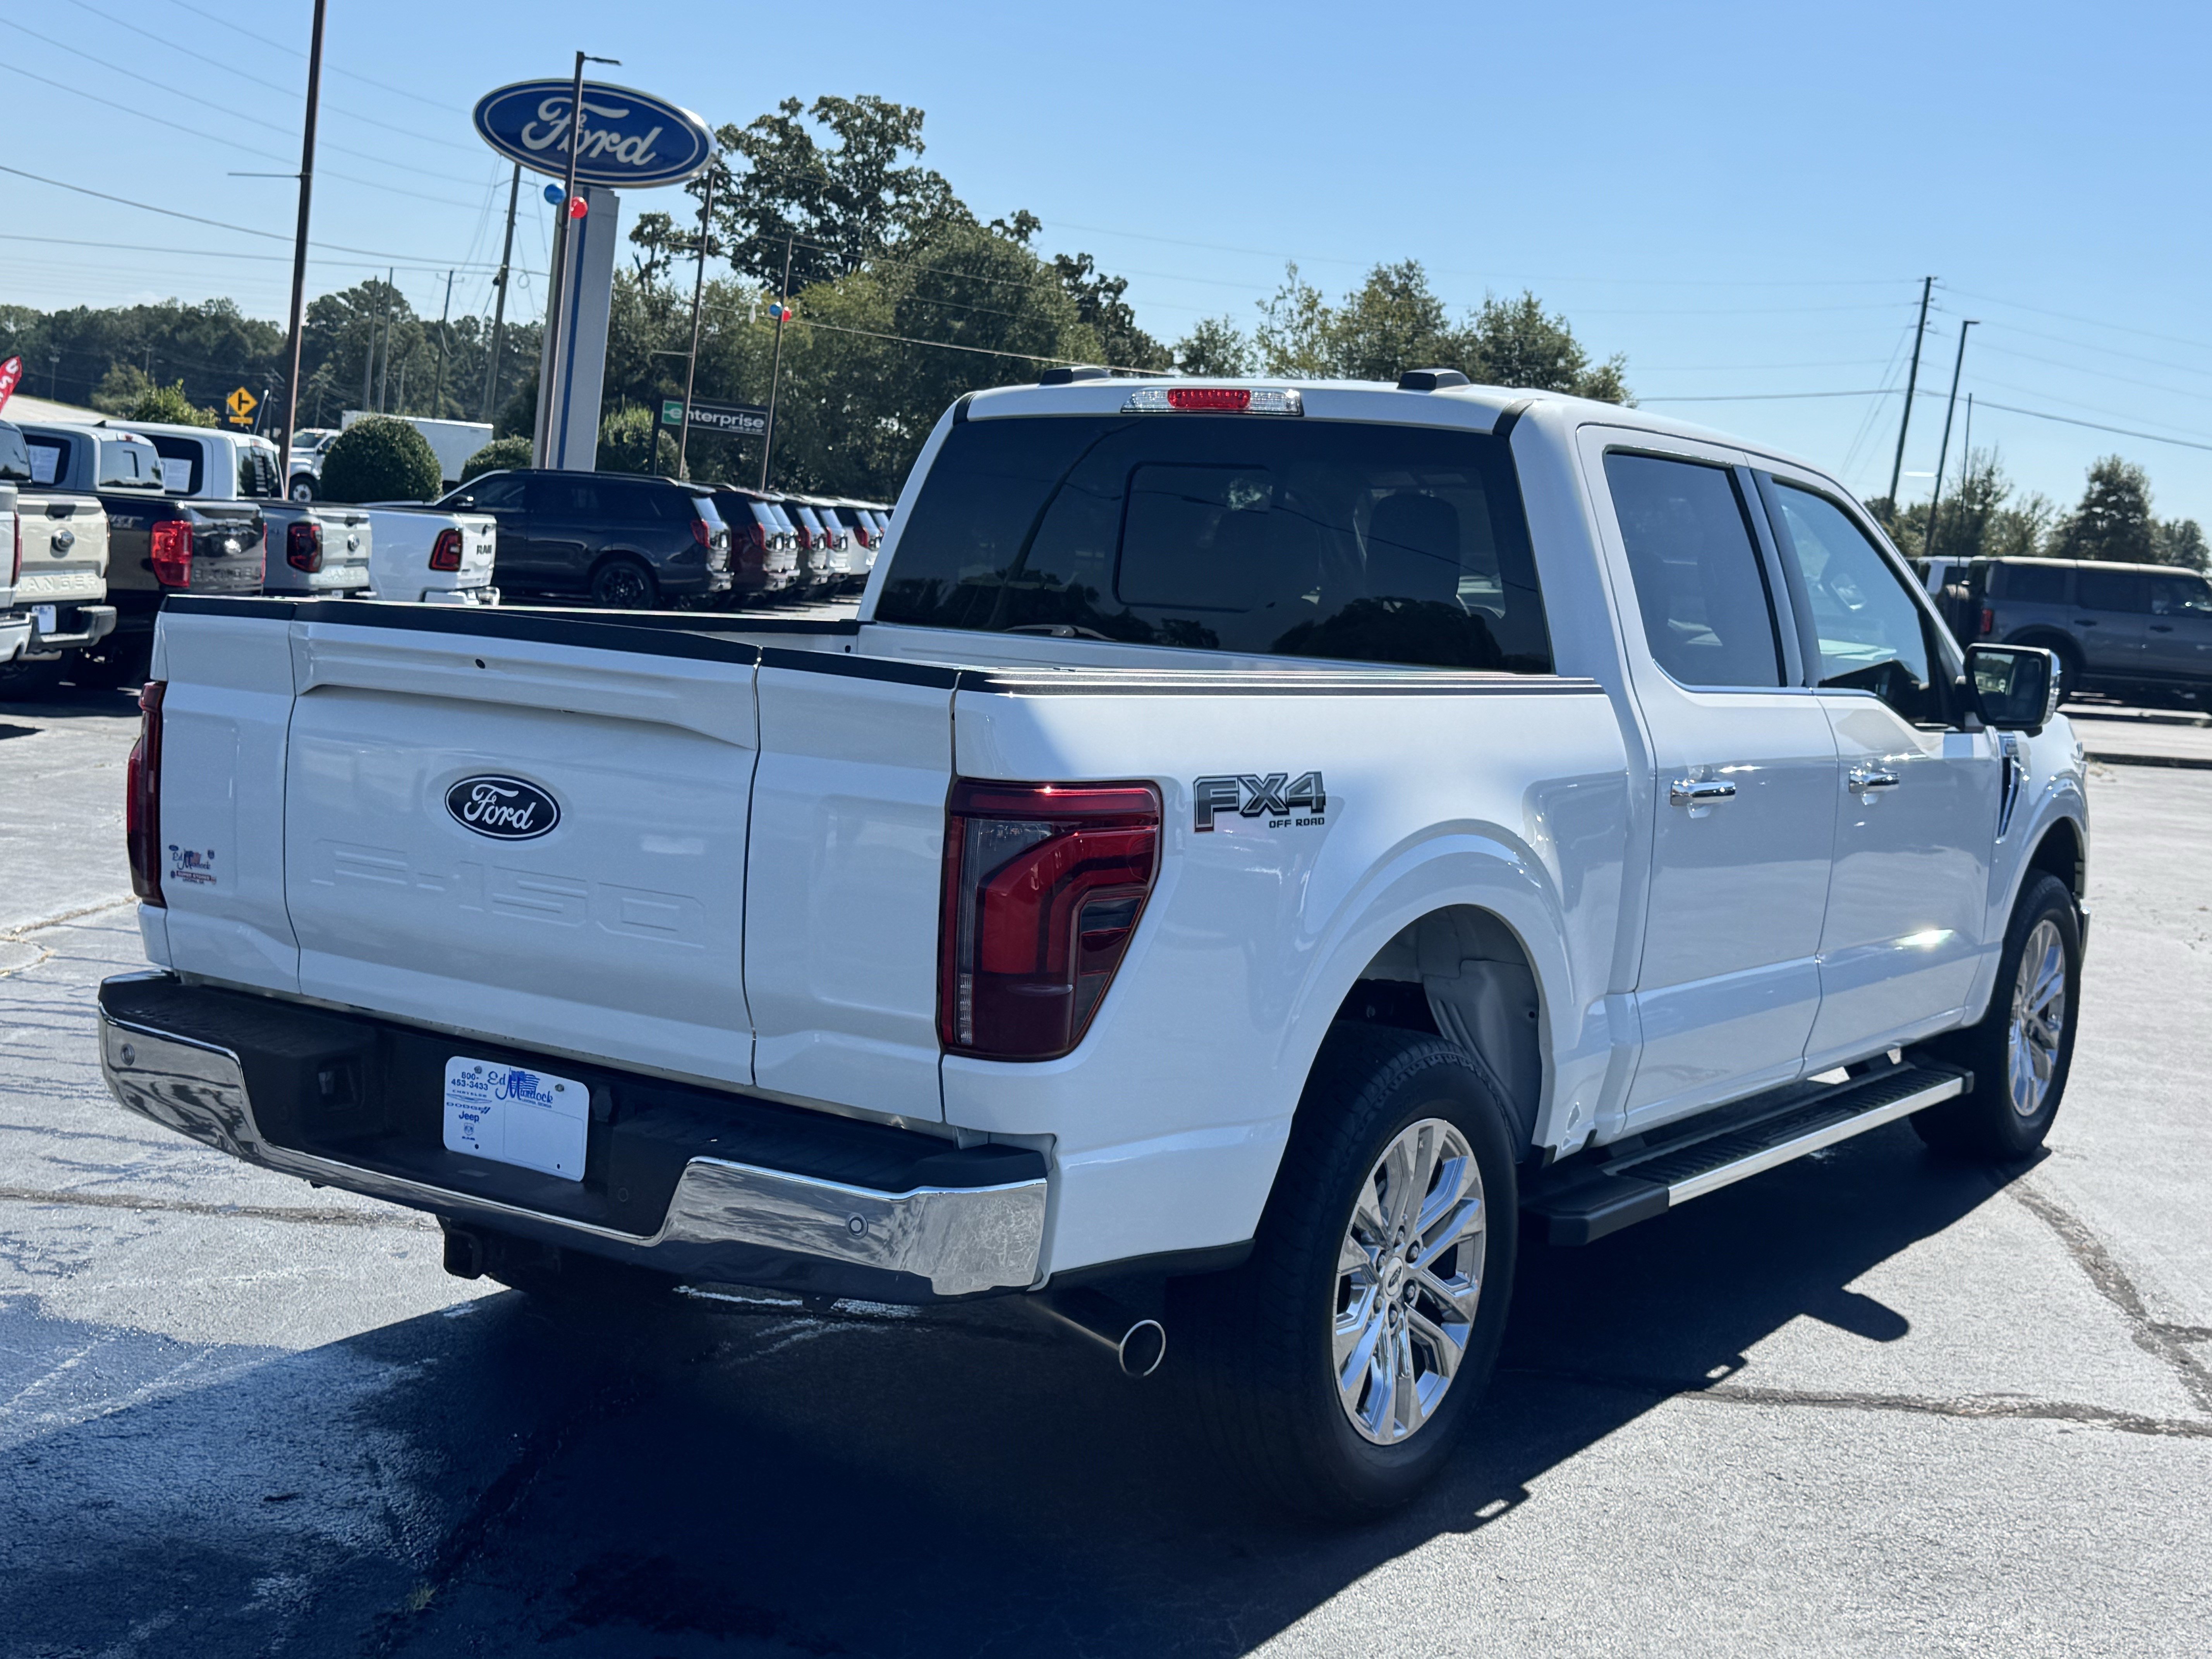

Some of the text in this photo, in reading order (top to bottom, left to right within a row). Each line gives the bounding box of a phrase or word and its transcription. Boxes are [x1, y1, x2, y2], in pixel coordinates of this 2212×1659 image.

[522, 96, 663, 166] Ford
[0, 358, 19, 404] US
[669, 408, 764, 428] enterprise
[18, 575, 98, 592] ANGER
[464, 784, 536, 830] Ford
[1193, 771, 1326, 833] FX4
[1269, 817, 1324, 828] OFF ROAD
[461, 1072, 479, 1080] 800-
[487, 1071, 506, 1085] Ed
[495, 1074, 553, 1103] Murdock
[459, 1111, 479, 1123] Jeep
